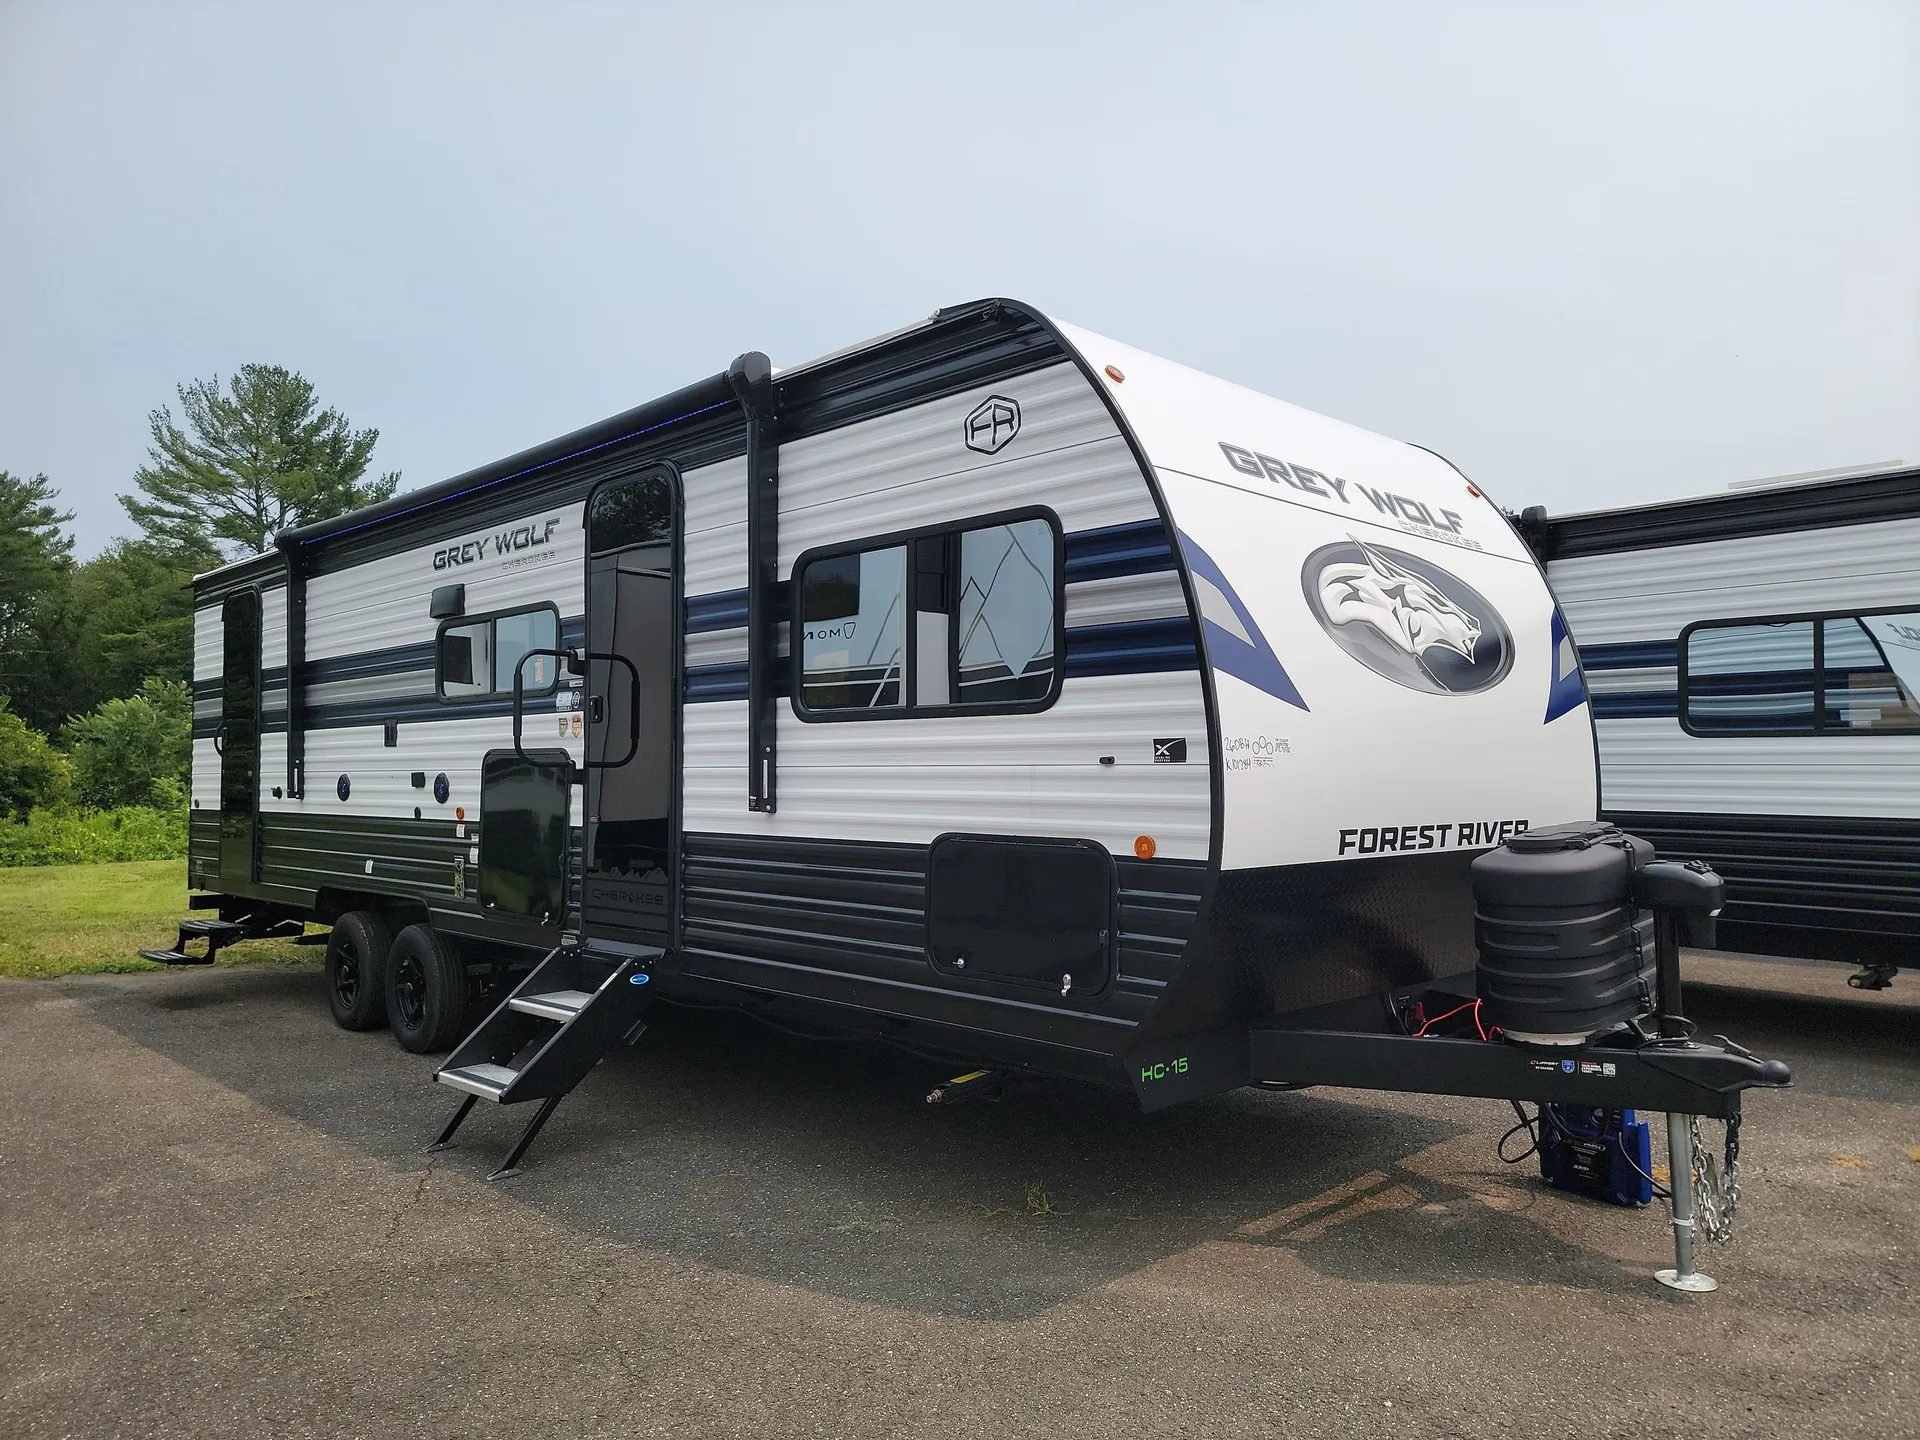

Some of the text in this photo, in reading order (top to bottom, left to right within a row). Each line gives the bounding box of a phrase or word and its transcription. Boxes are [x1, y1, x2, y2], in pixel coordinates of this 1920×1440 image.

[1218, 441, 1464, 535] GREY WOLF
[433, 517, 560, 571] GREY WOLF
[1398, 519, 1483, 550] CHEROKEE
[501, 550, 556, 570] CHEROKEE
[1338, 819, 1529, 856] FOREST RIVER
